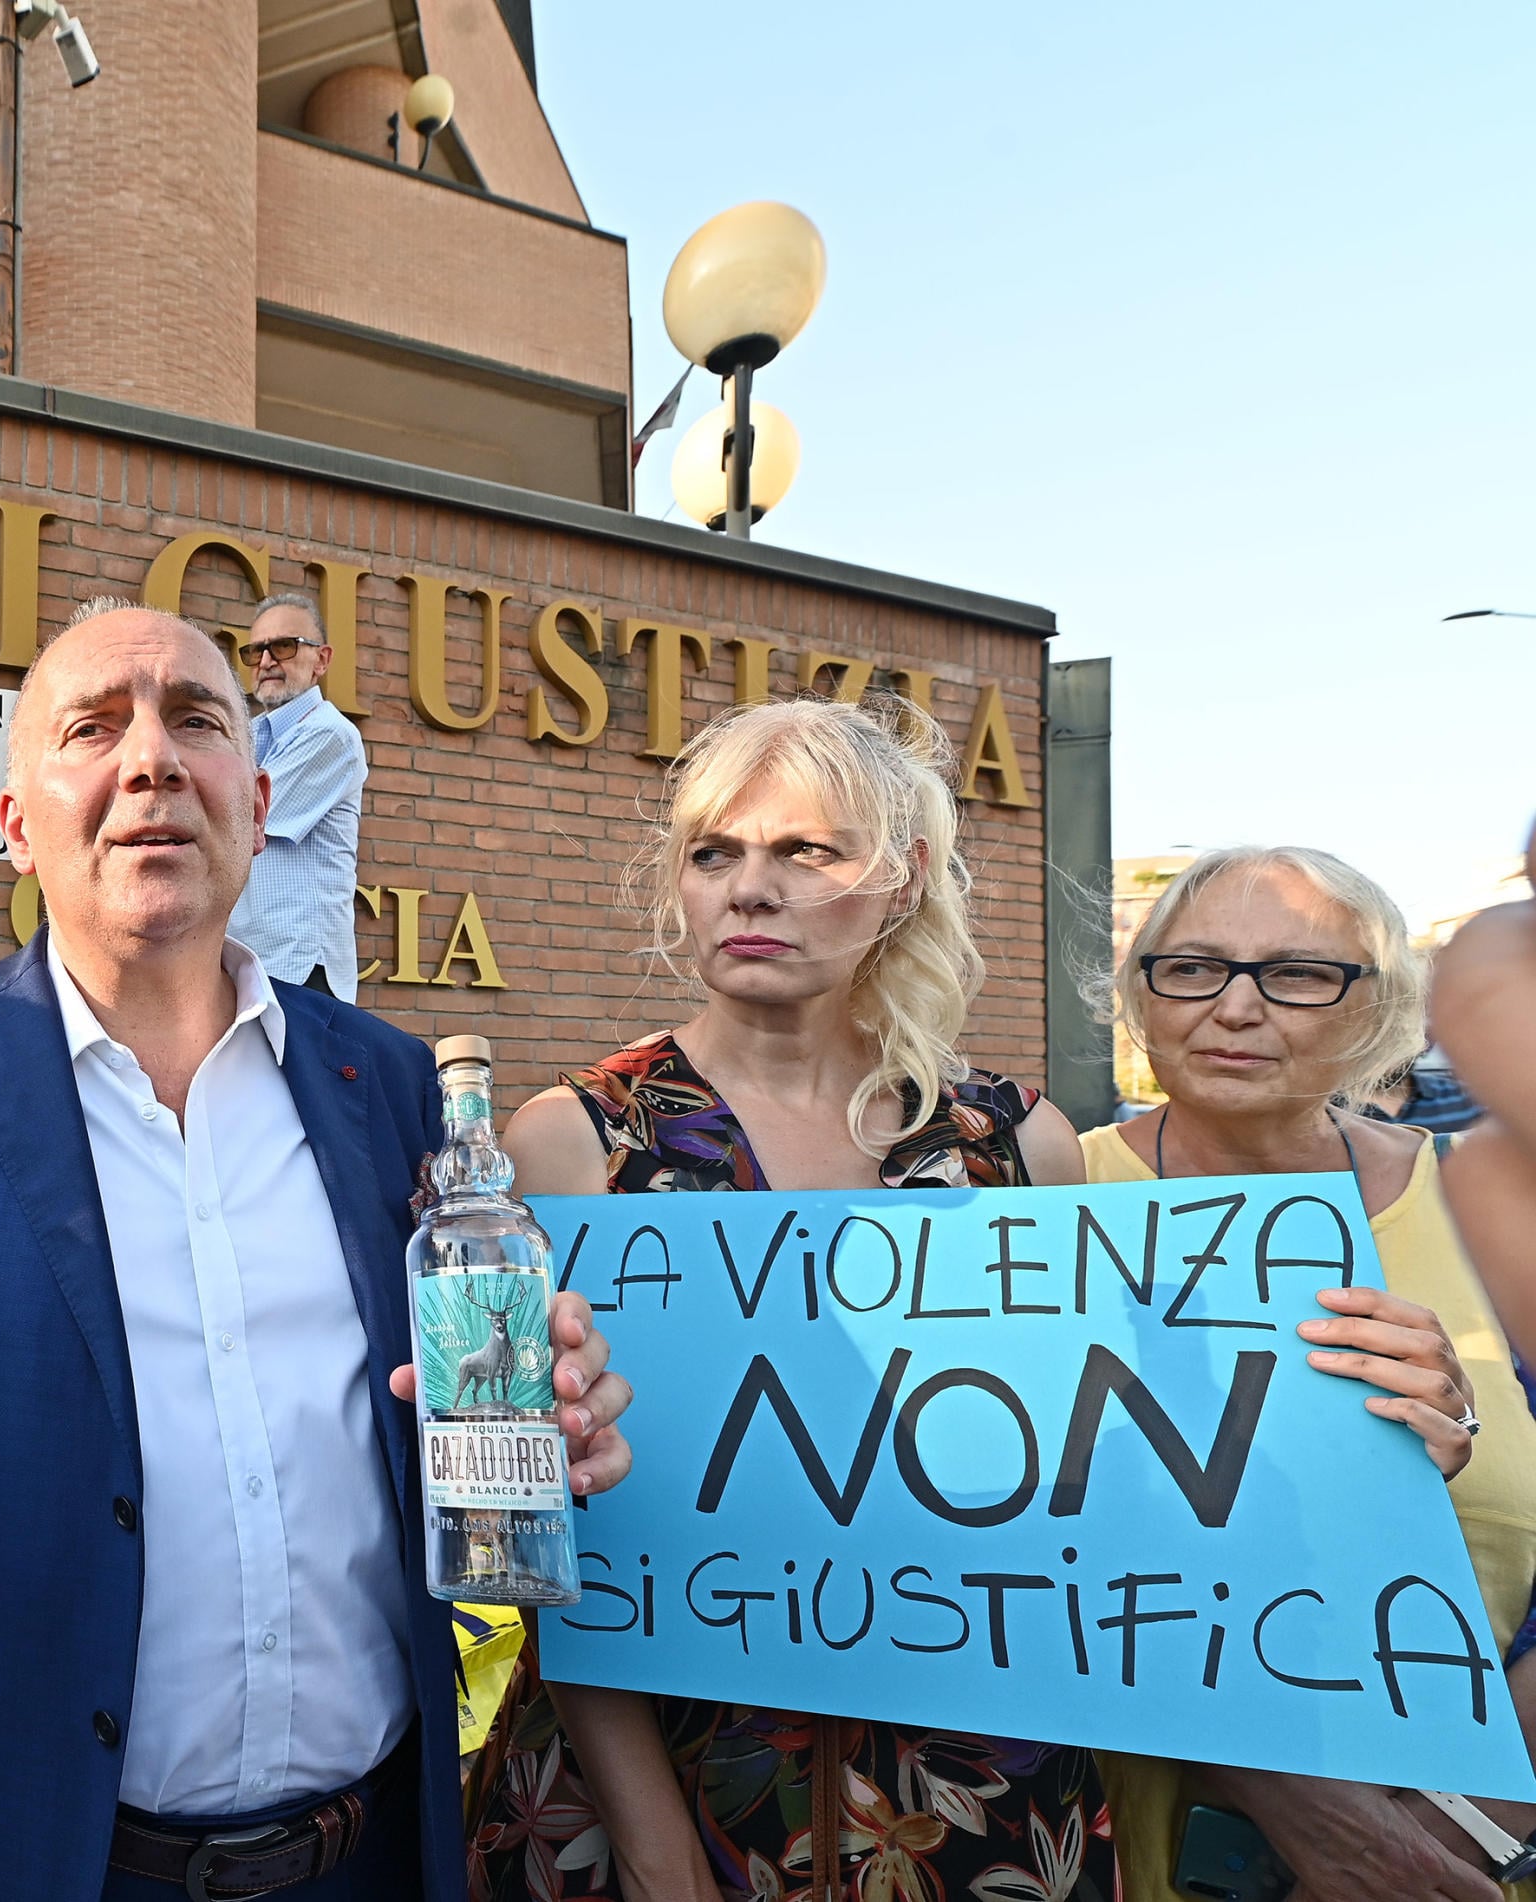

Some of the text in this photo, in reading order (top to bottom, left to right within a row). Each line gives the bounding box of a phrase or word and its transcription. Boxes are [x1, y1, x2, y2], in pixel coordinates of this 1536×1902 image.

[558, 1222, 683, 1311] LA
[465, 1424, 515, 1435] TEQUILA
[695, 1343, 1279, 1529] NON
[469, 1485, 517, 1496] BLANCO
